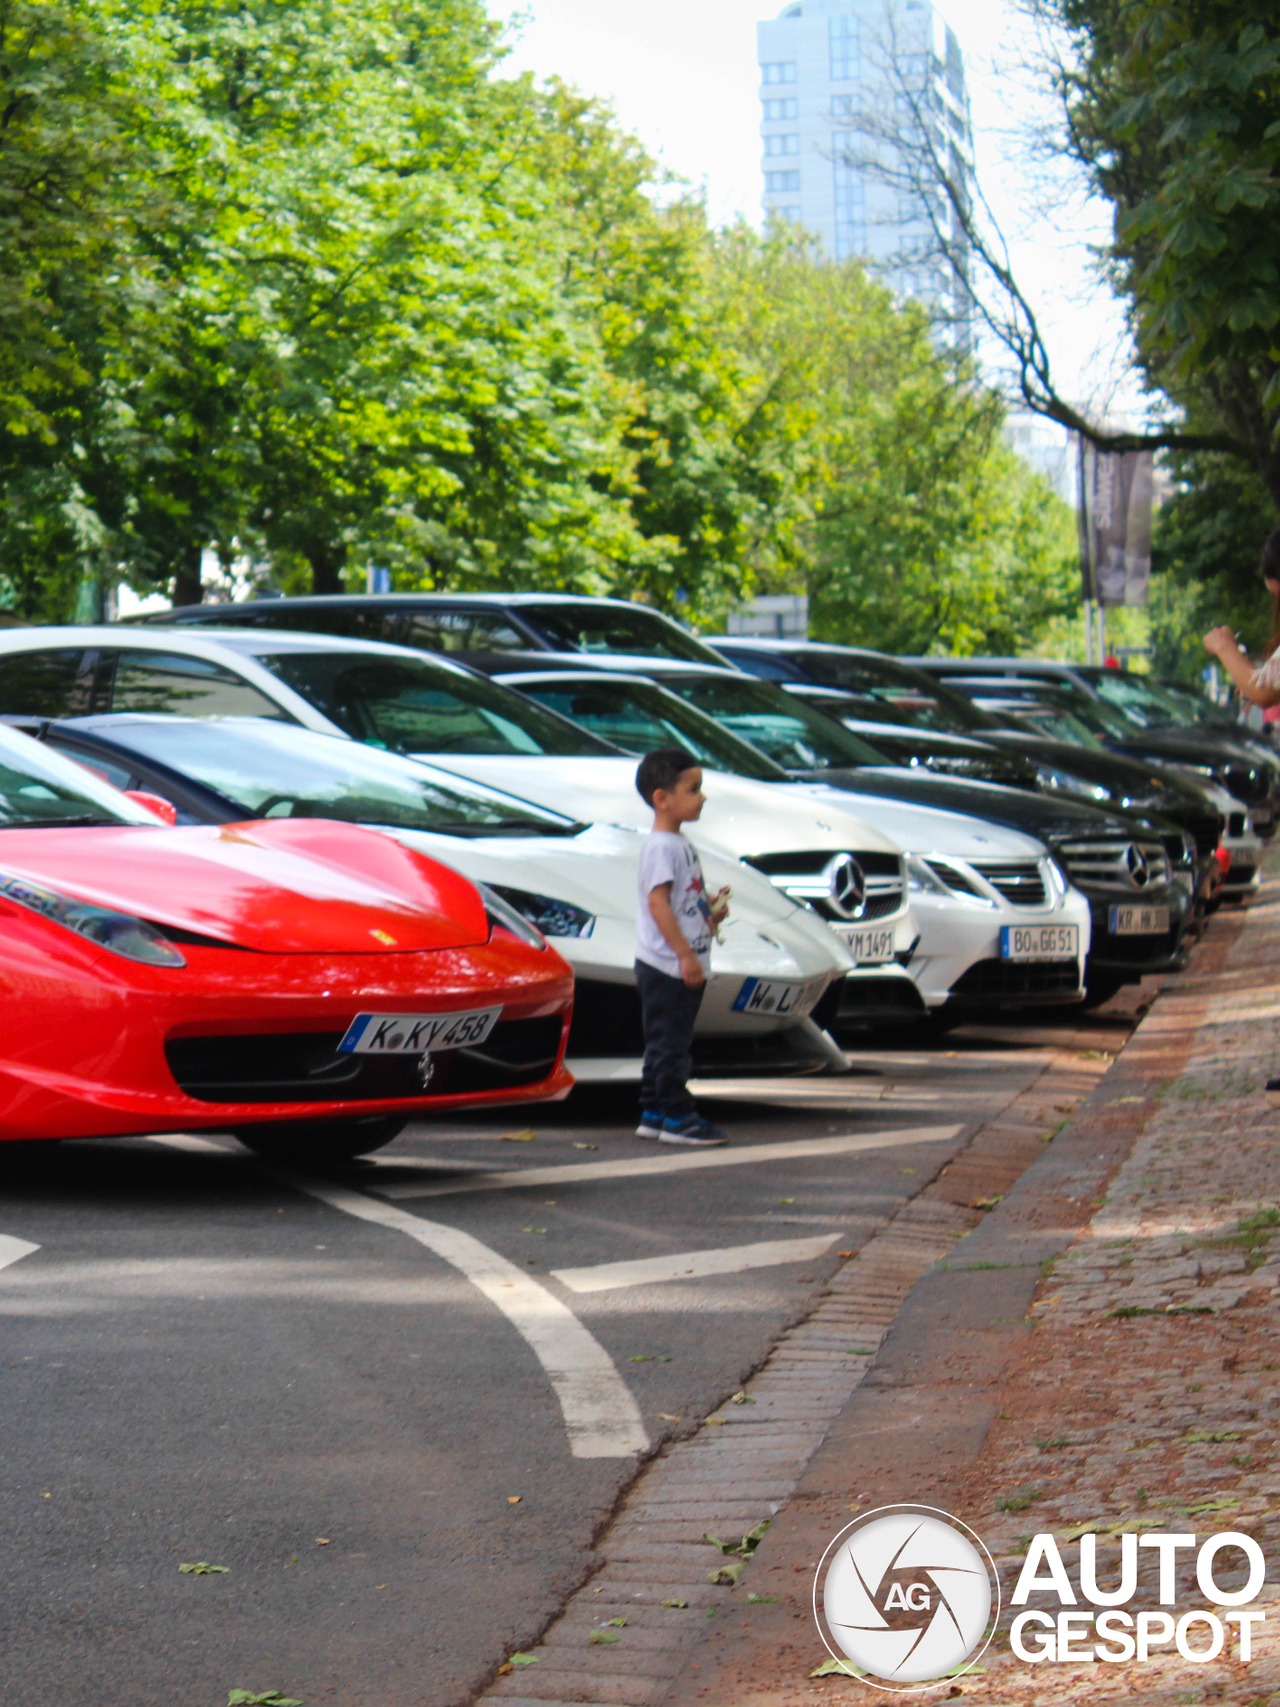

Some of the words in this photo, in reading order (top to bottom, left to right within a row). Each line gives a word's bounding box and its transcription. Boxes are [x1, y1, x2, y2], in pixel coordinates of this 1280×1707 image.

[865, 931, 893, 957] 1491
[1014, 930, 1031, 953] BO
[1040, 929, 1057, 952] GG
[1058, 929, 1072, 952] 51
[749, 982, 773, 1010] W
[368, 1019, 399, 1049] K
[403, 1020, 448, 1049] KY
[441, 1013, 490, 1046] 458
